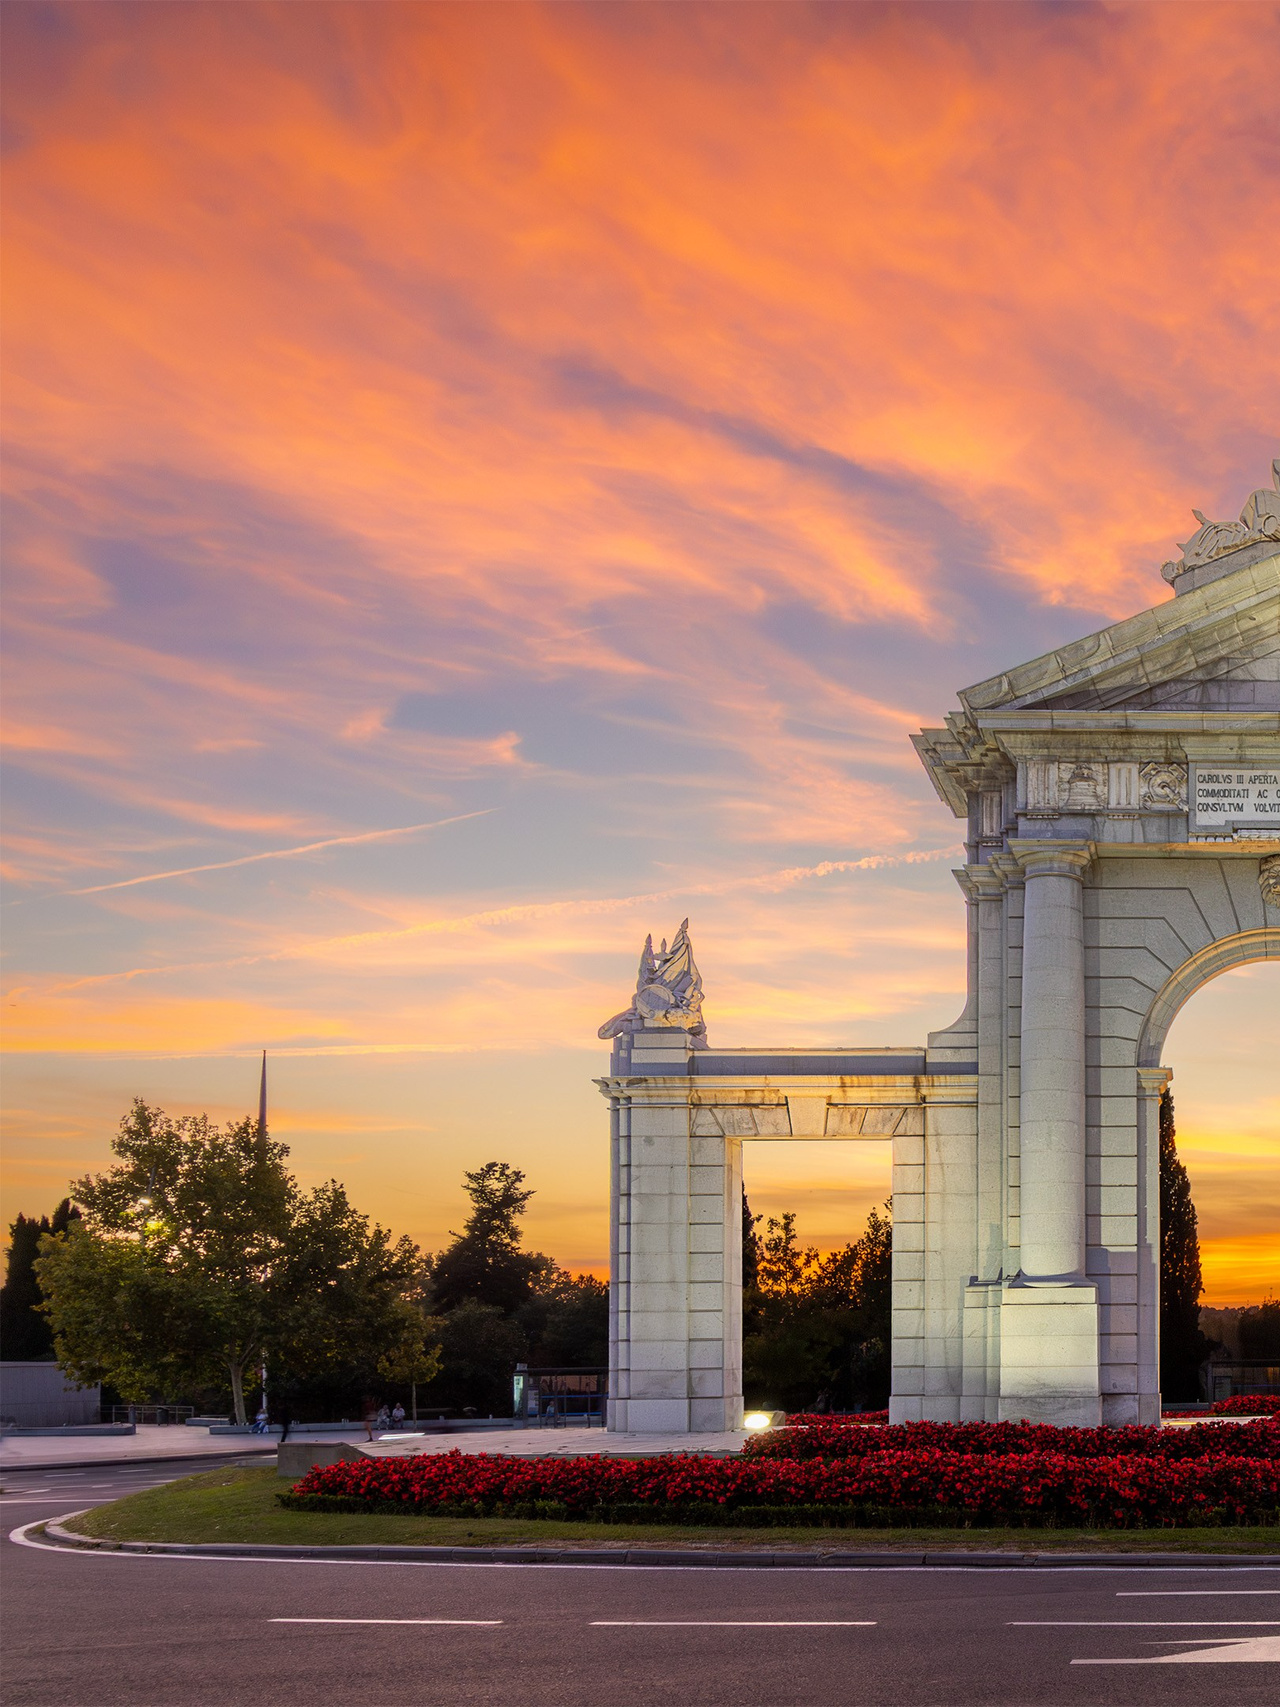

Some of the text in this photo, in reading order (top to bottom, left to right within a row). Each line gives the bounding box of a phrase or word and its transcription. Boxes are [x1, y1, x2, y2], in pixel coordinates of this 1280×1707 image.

[1197, 774, 1233, 784] CAROLVS
[1236, 774, 1244, 784] III
[1248, 774, 1278, 785] APERTA
[1197, 788, 1249, 799] COMMODITATI
[1257, 789, 1268, 799] AC
[1197, 802, 1244, 813] CONSVLTVM
[1253, 803, 1280, 813] VOLVIT
